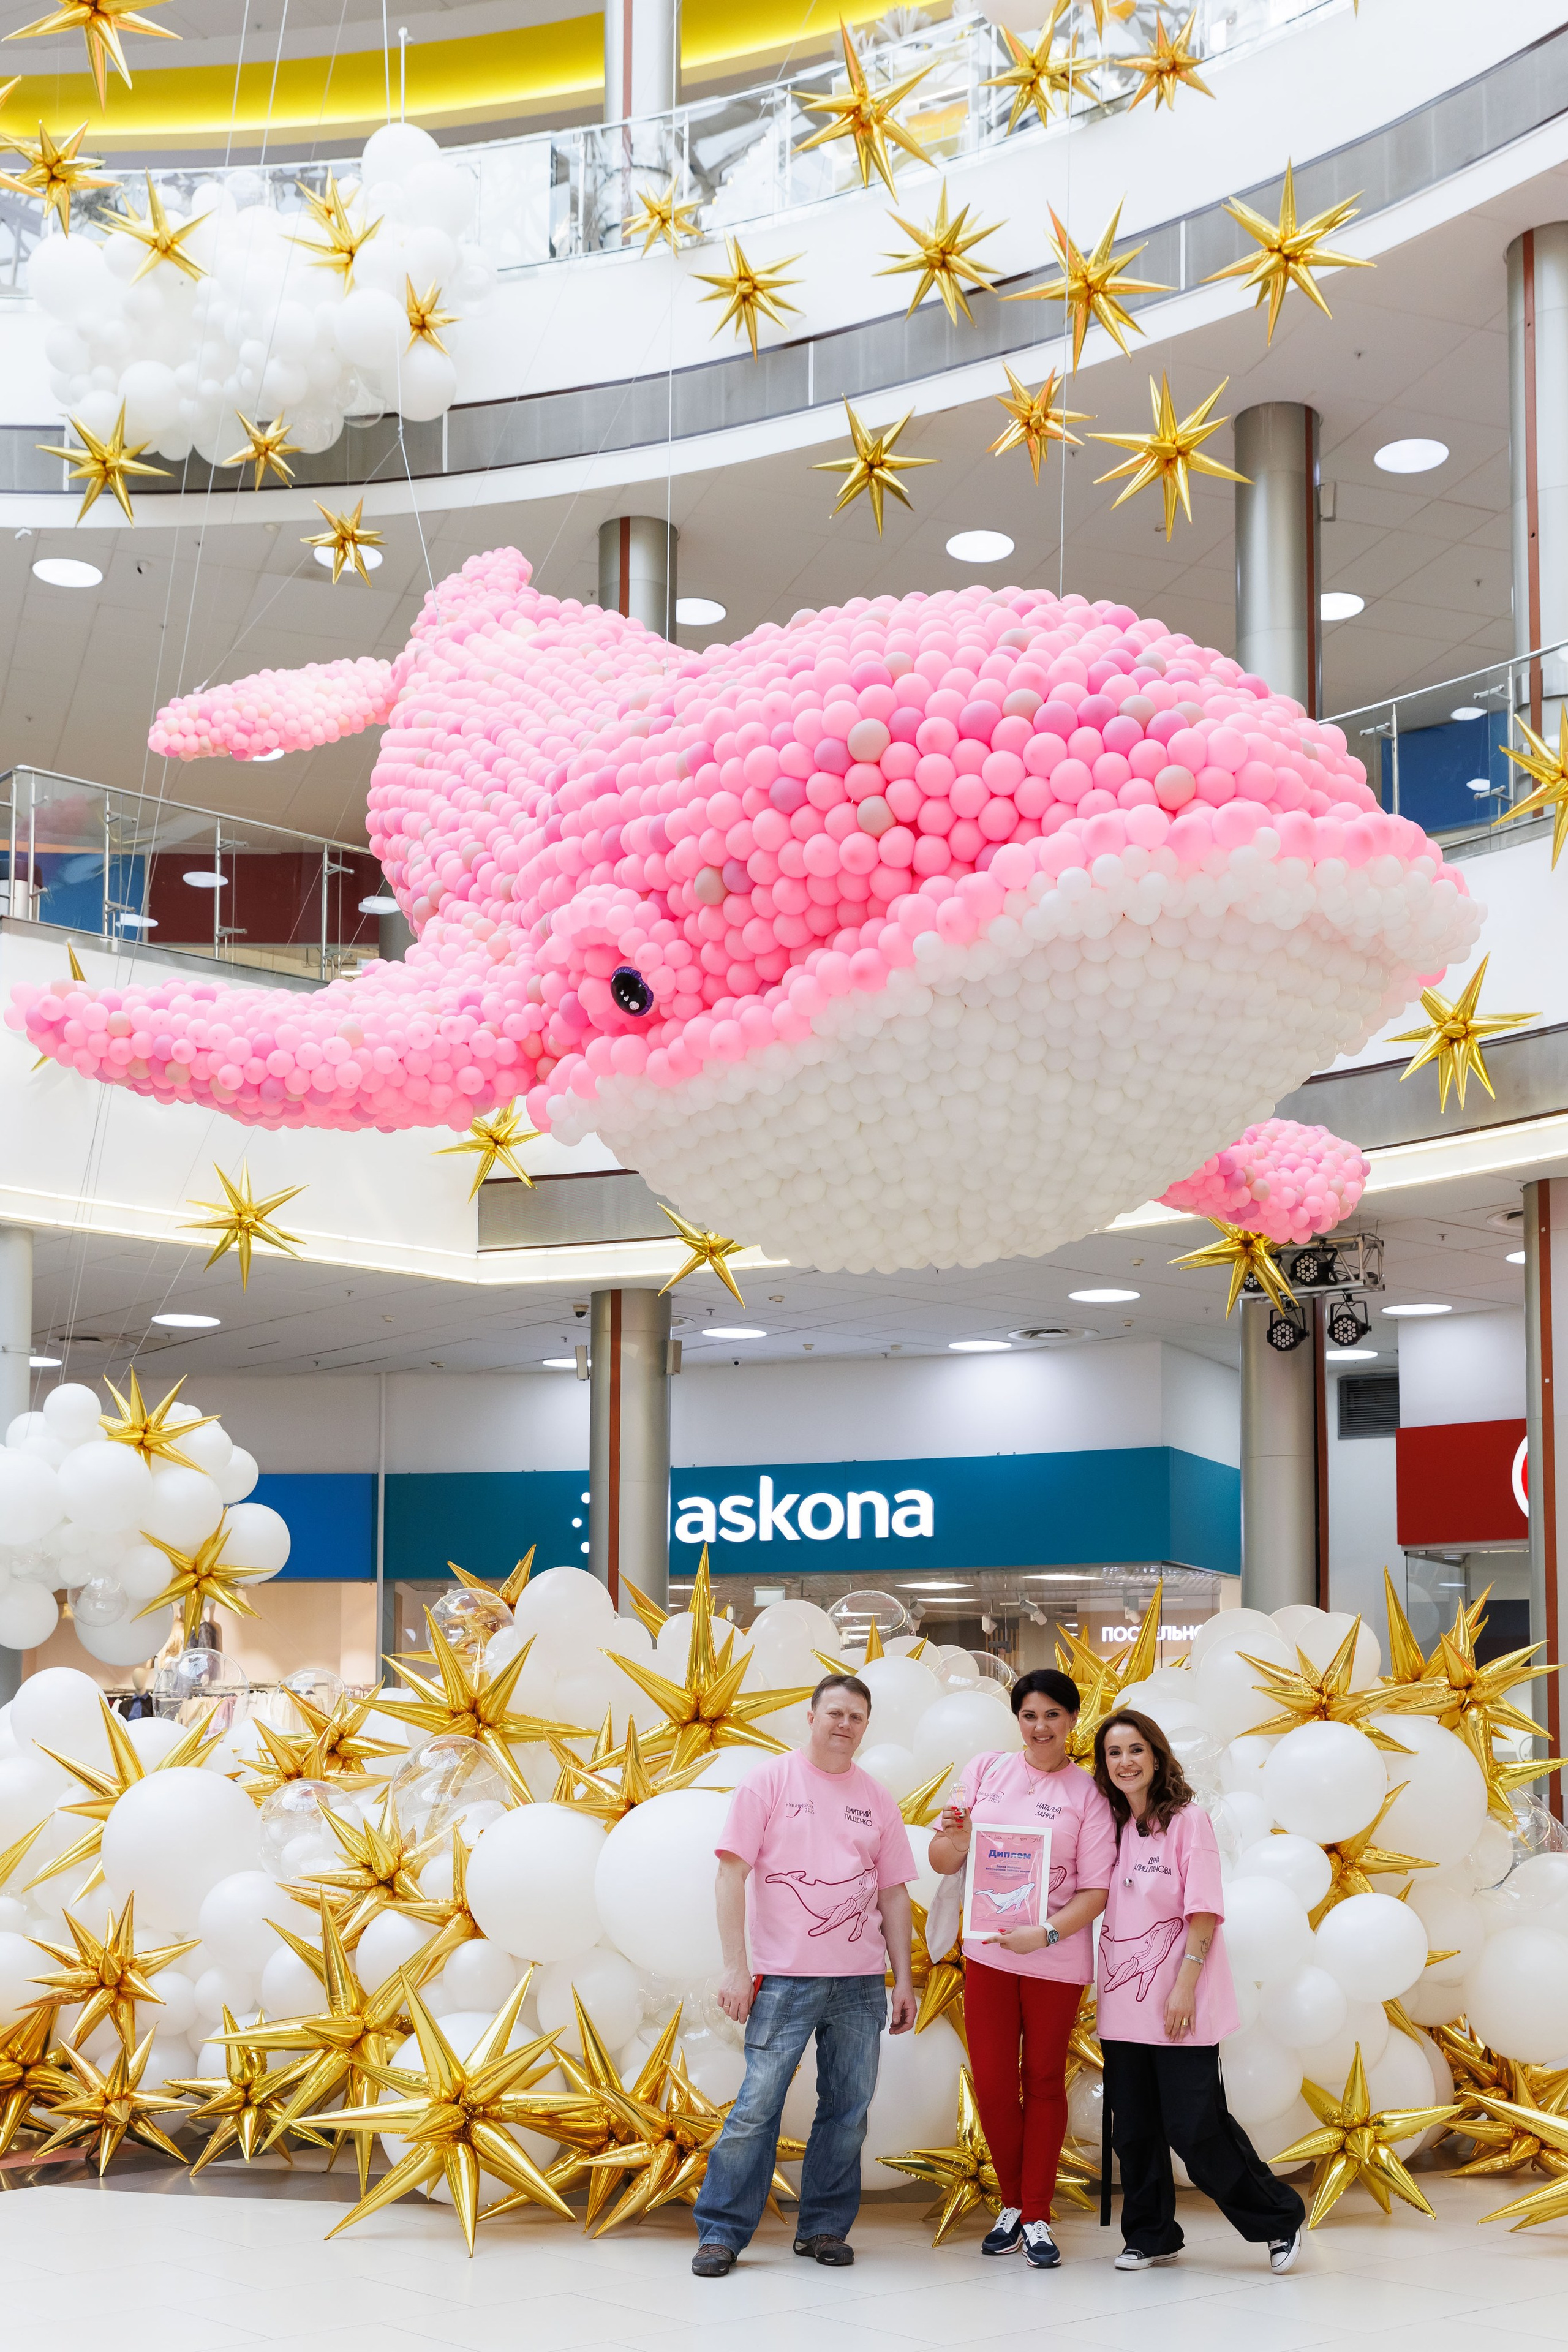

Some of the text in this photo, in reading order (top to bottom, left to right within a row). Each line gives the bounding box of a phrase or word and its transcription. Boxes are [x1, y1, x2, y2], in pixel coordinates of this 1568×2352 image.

[674, 1474, 934, 1544] askona
[845, 1806, 872, 1817] ДМИТРИЙ
[1036, 1802, 1062, 1814] НАТАЛЬЯ
[844, 1813, 873, 1826] ТИЩЕНКО
[1035, 1810, 1055, 1820] ЗАИКА
[988, 1849, 1031, 1859] Диплом
[1148, 1856, 1160, 1864] ДИНА
